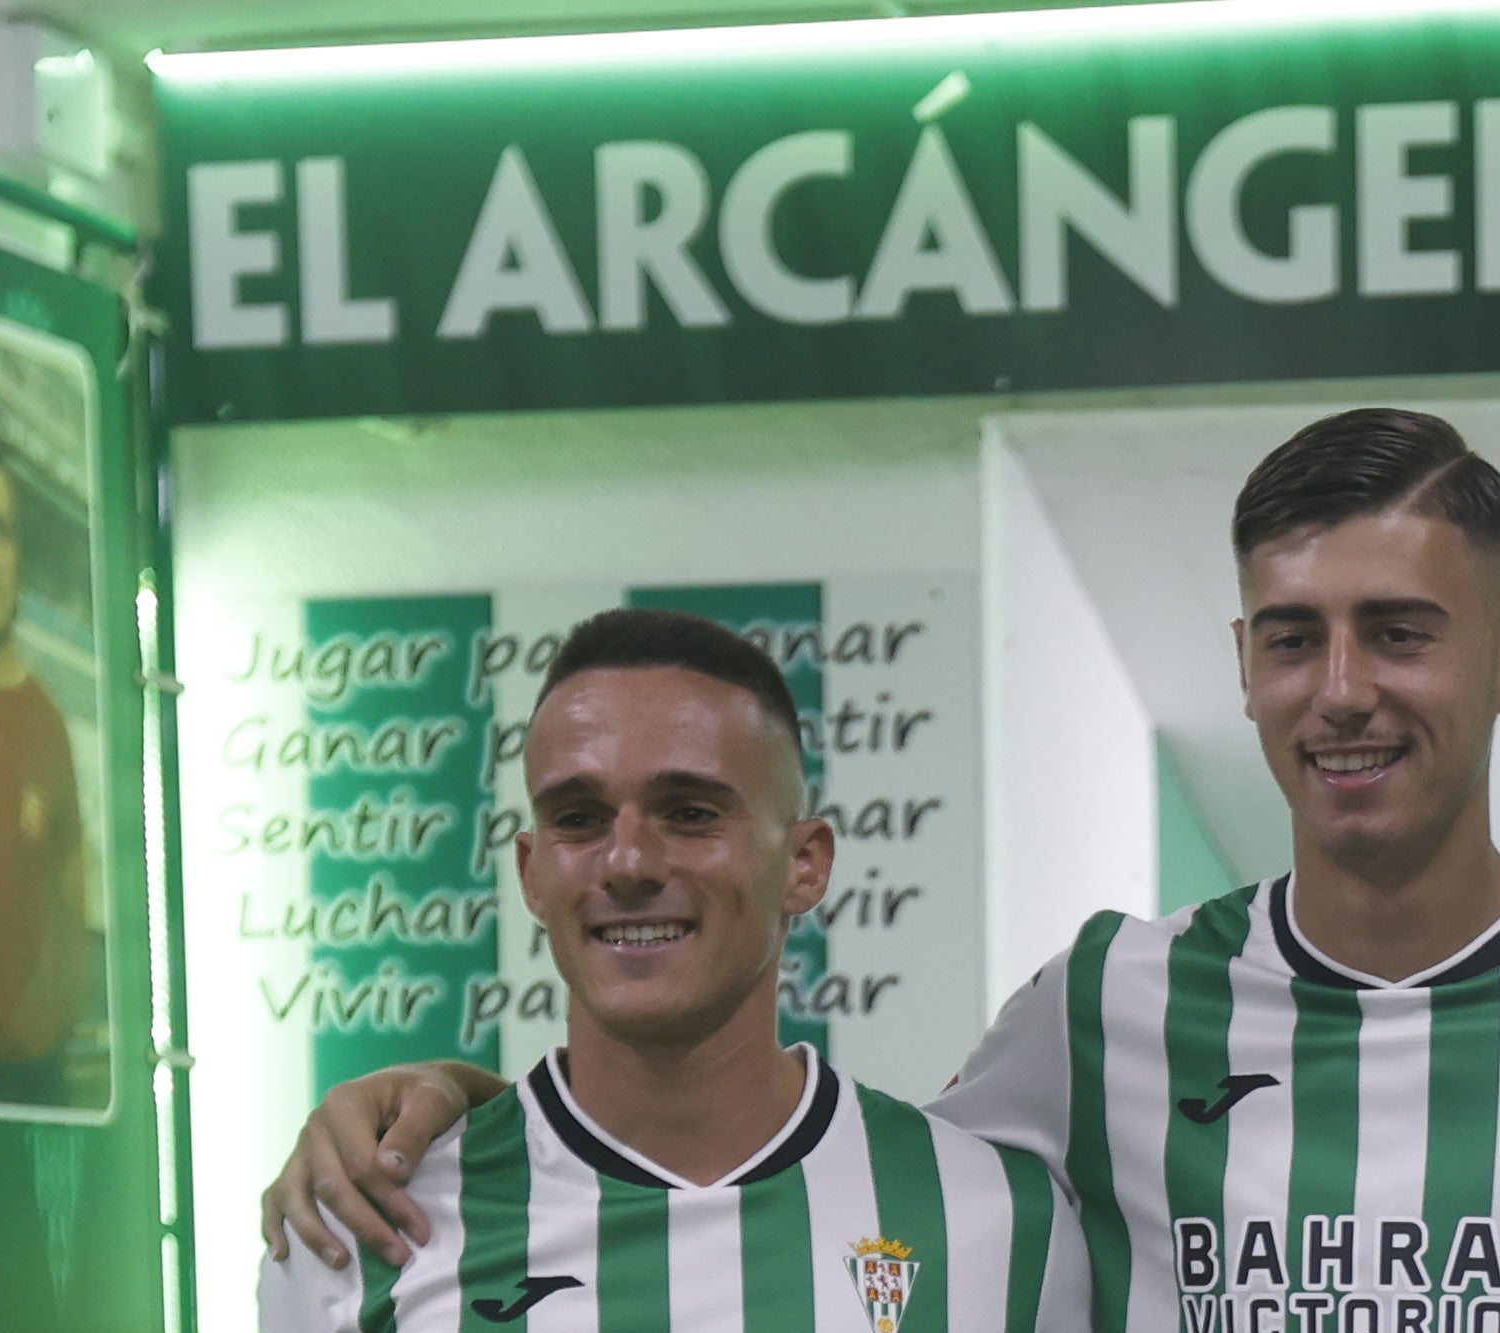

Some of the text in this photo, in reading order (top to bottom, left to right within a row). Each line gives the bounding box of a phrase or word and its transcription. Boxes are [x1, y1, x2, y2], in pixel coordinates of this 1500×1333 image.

[187, 156, 397, 349] EL
[230, 619, 924, 703] Jugar pa anar
[220, 714, 461, 777] Ganar
[217, 787, 450, 856] Sentir
[239, 873, 501, 943] Luchar
[258, 963, 439, 1029] Vivir
[462, 977, 555, 1046] pa
